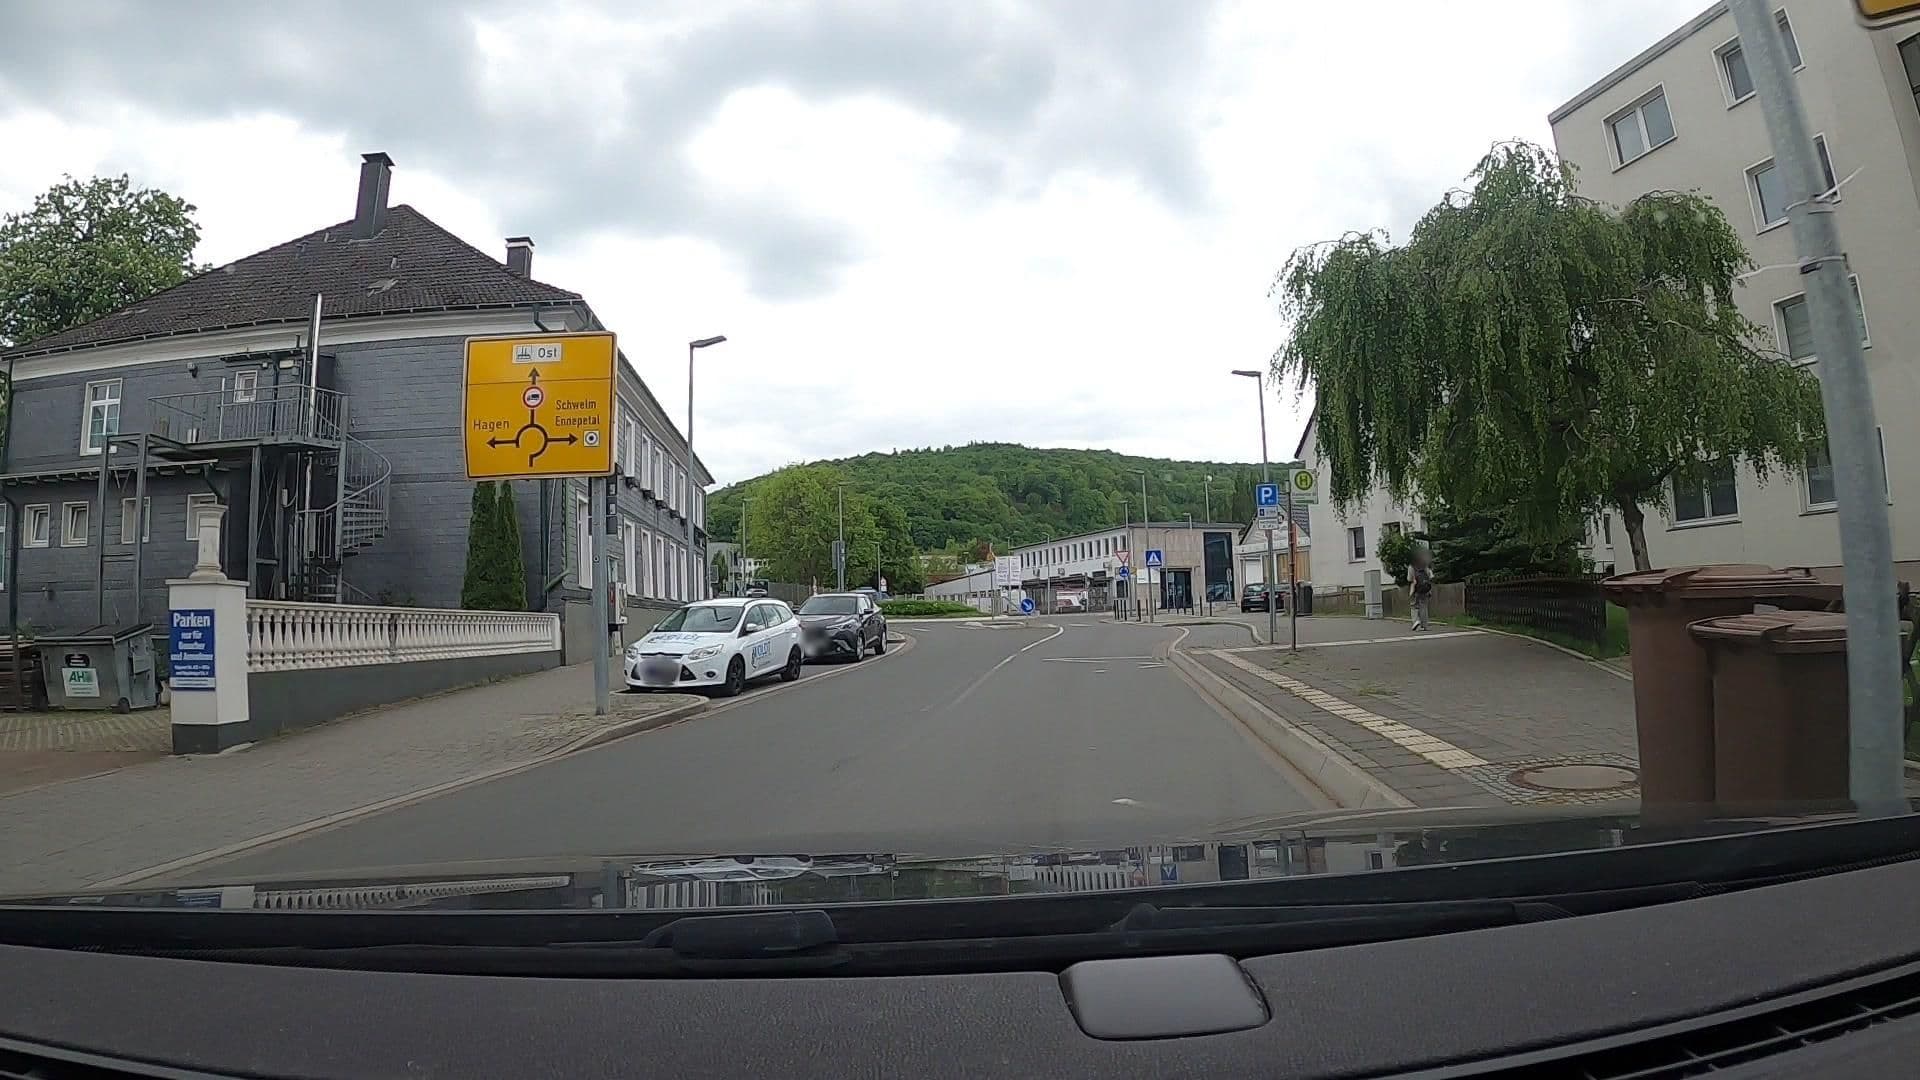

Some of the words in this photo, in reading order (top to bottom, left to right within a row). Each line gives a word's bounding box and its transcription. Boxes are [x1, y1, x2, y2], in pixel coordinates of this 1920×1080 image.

[538, 347, 557, 358] Ost
[555, 399, 597, 410] Schwelm
[473, 418, 510, 432] Hagen
[555, 415, 600, 428] Ennepetal
[1299, 475, 1308, 486] H
[1261, 487, 1273, 505] P
[173, 612, 210, 627] Parken
